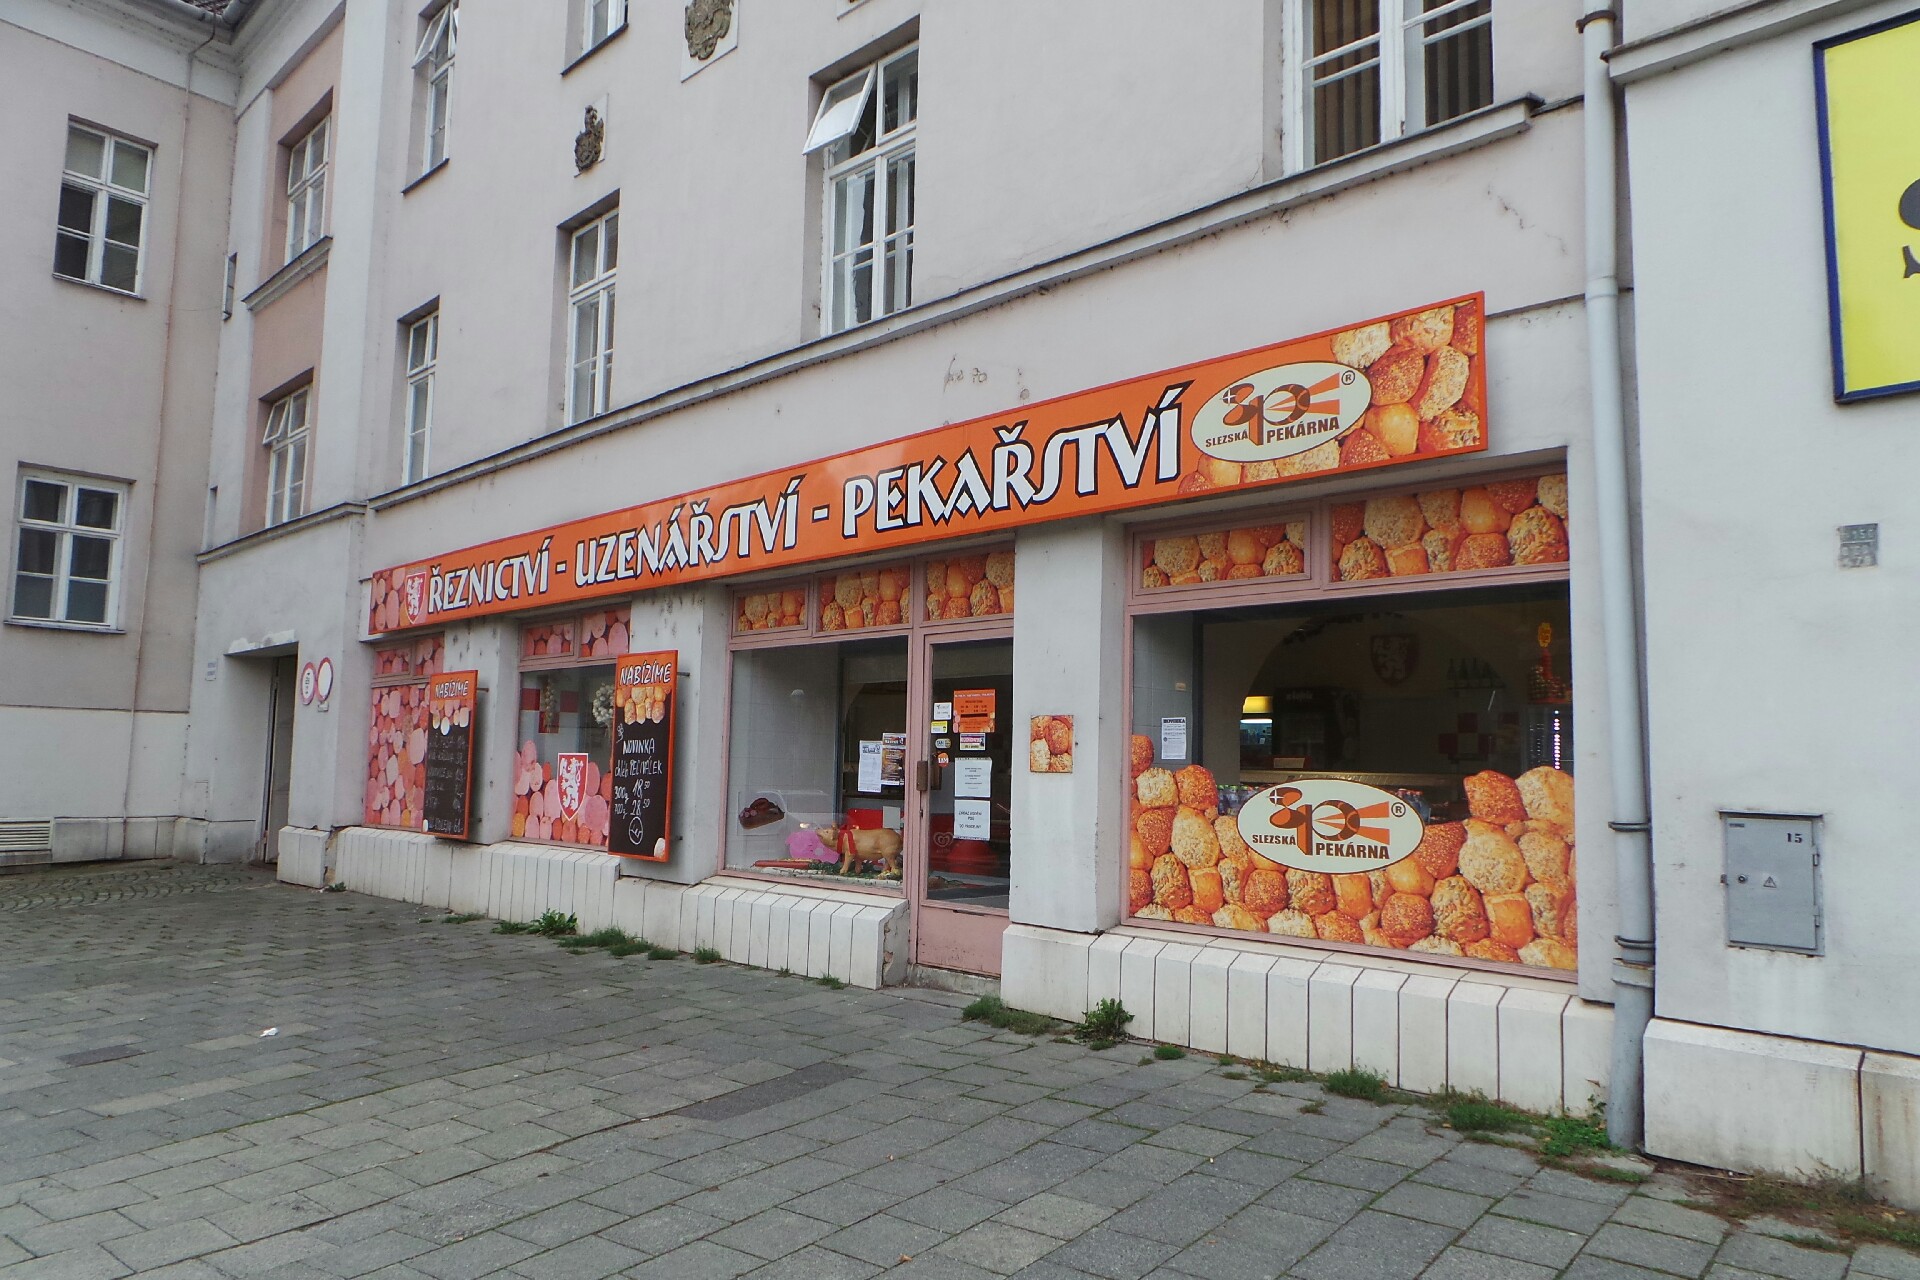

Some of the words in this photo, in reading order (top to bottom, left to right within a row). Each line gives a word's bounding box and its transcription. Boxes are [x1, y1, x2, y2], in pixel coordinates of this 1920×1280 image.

[1205, 430, 1249, 448] SLEZSKÁ
[1266, 416, 1340, 444] PEKÁRNA
[427, 537, 553, 614] ŘEZNICTVÍ
[575, 475, 806, 588] UZENÁŘSTVÍ
[842, 381, 1192, 539] PEKAŘSTVÍ
[620, 659, 672, 686] NABÍZÍME
[622, 737, 655, 755] NOVINKA
[1252, 834, 1296, 846] SLEZSKÁ
[1315, 841, 1390, 860] PEKÁRNA
[1786, 832, 1803, 844] 15
